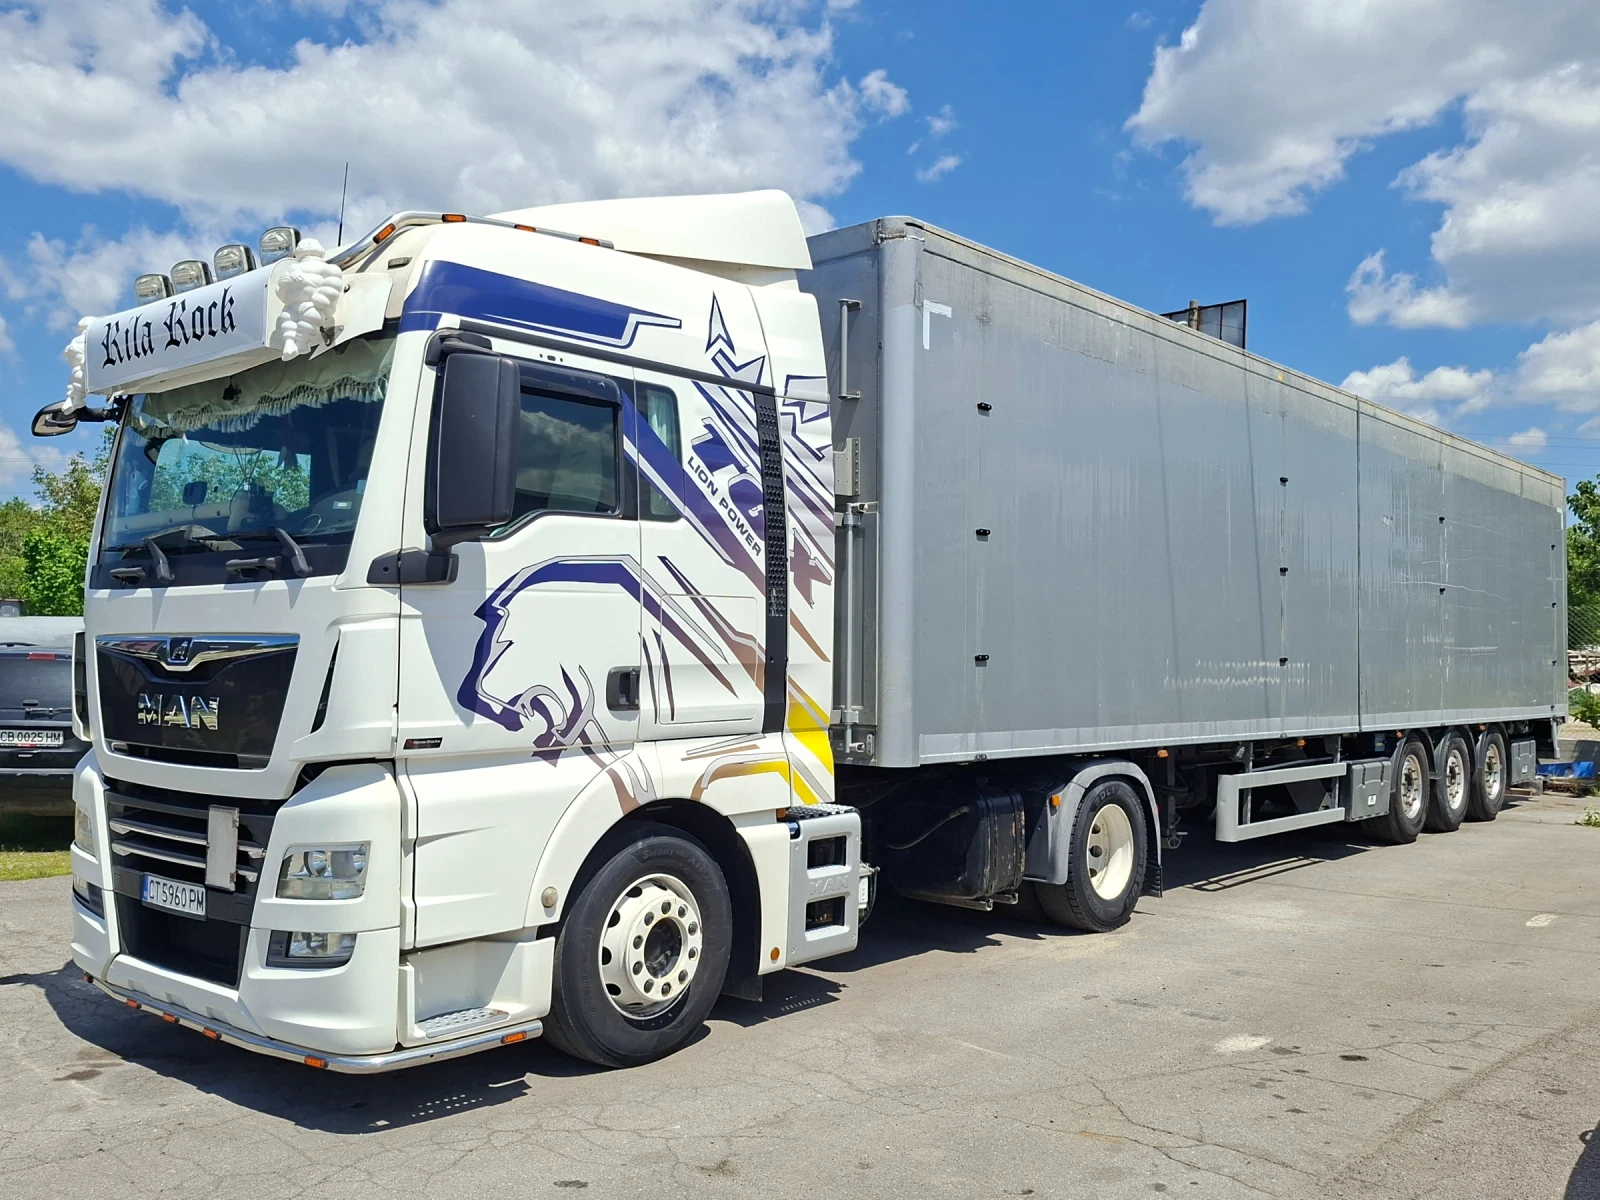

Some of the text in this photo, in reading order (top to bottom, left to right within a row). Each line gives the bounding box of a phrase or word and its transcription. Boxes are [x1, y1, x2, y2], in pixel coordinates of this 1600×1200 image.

[101, 285, 236, 369] Rila Rock
[688, 456, 762, 556] LION POWER
[138, 693, 219, 730] MAN
[0, 731, 61, 743] CB 0025 HM
[149, 879, 204, 912] CT 5960 PM
[809, 875, 850, 896] MAN
